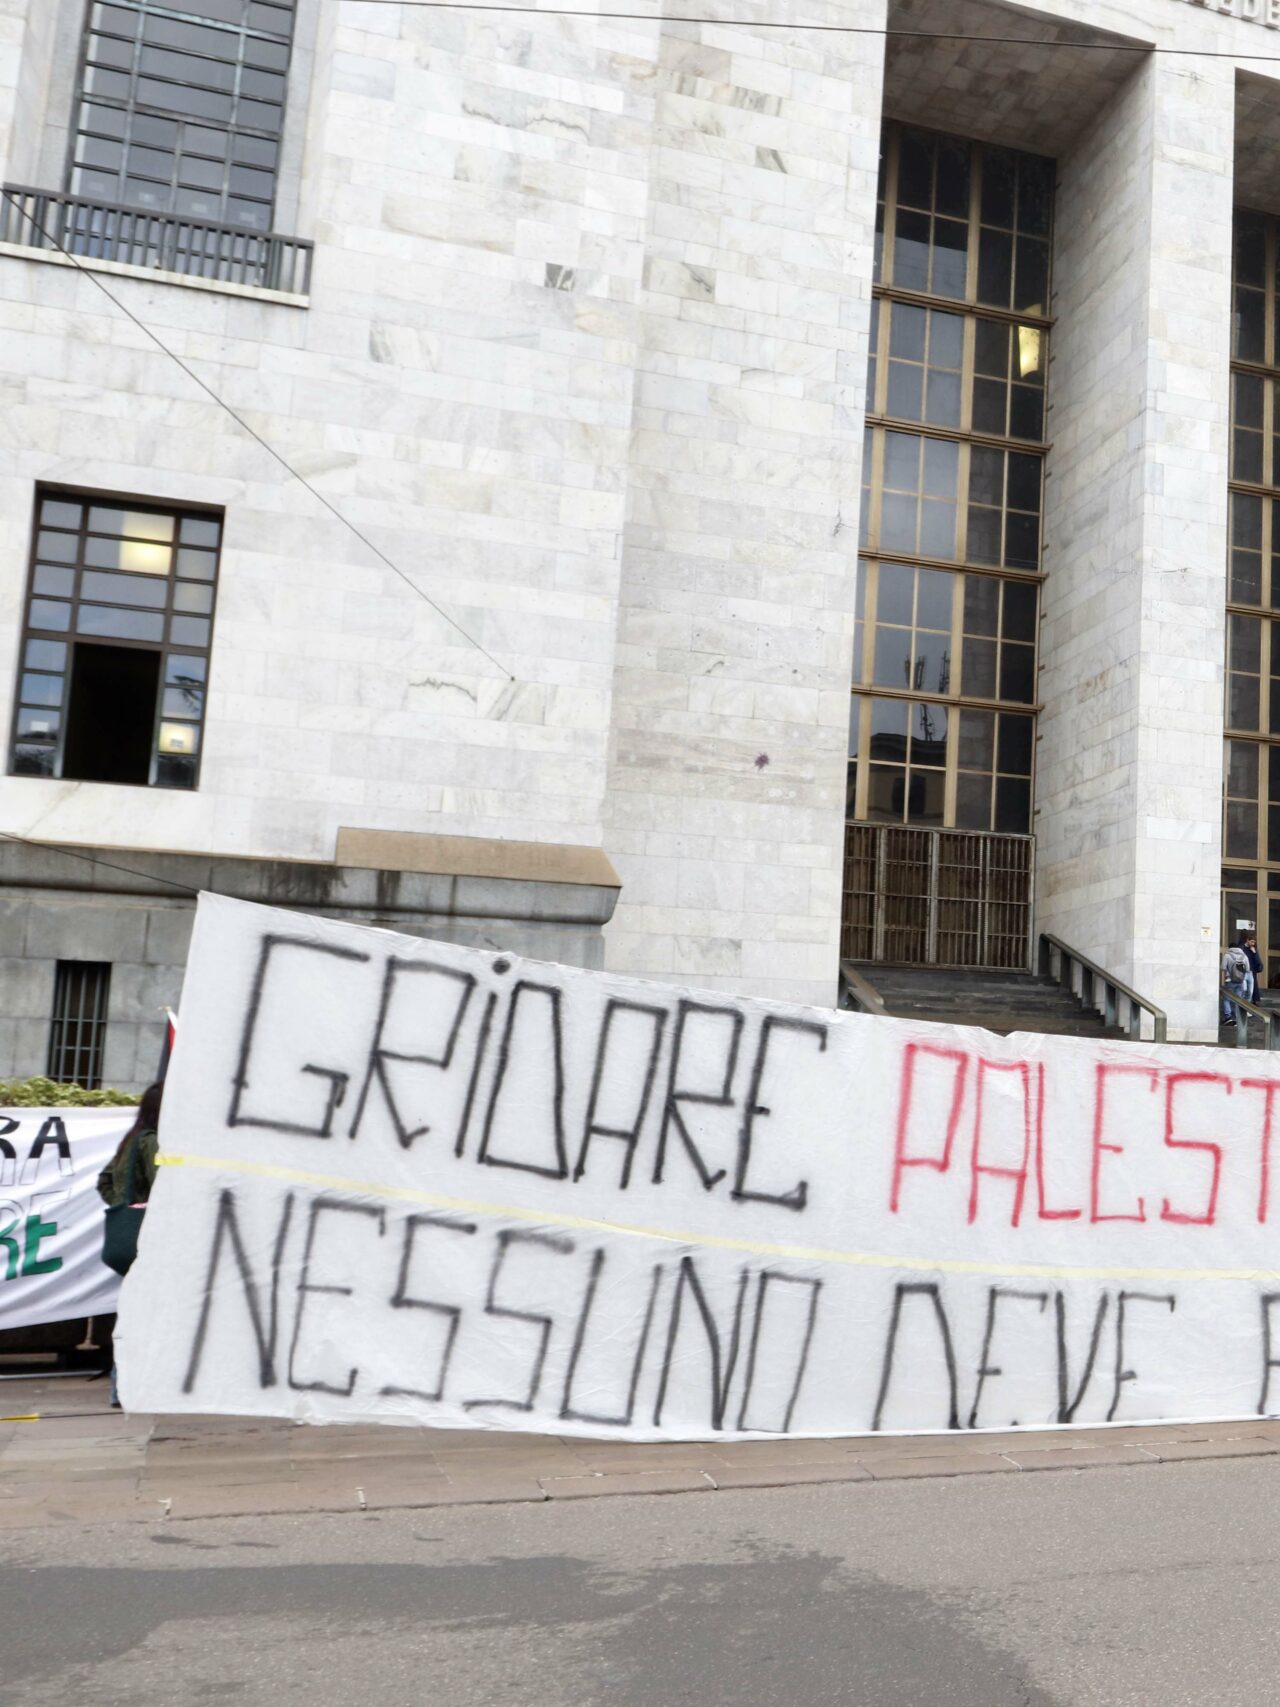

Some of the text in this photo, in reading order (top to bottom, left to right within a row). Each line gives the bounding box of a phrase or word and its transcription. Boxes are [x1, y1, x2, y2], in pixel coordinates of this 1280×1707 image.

[226, 933, 829, 1212] GRIDARE
[183, 1186, 823, 1433] NESSUNO
[871, 1282, 1176, 1431] DEVE
